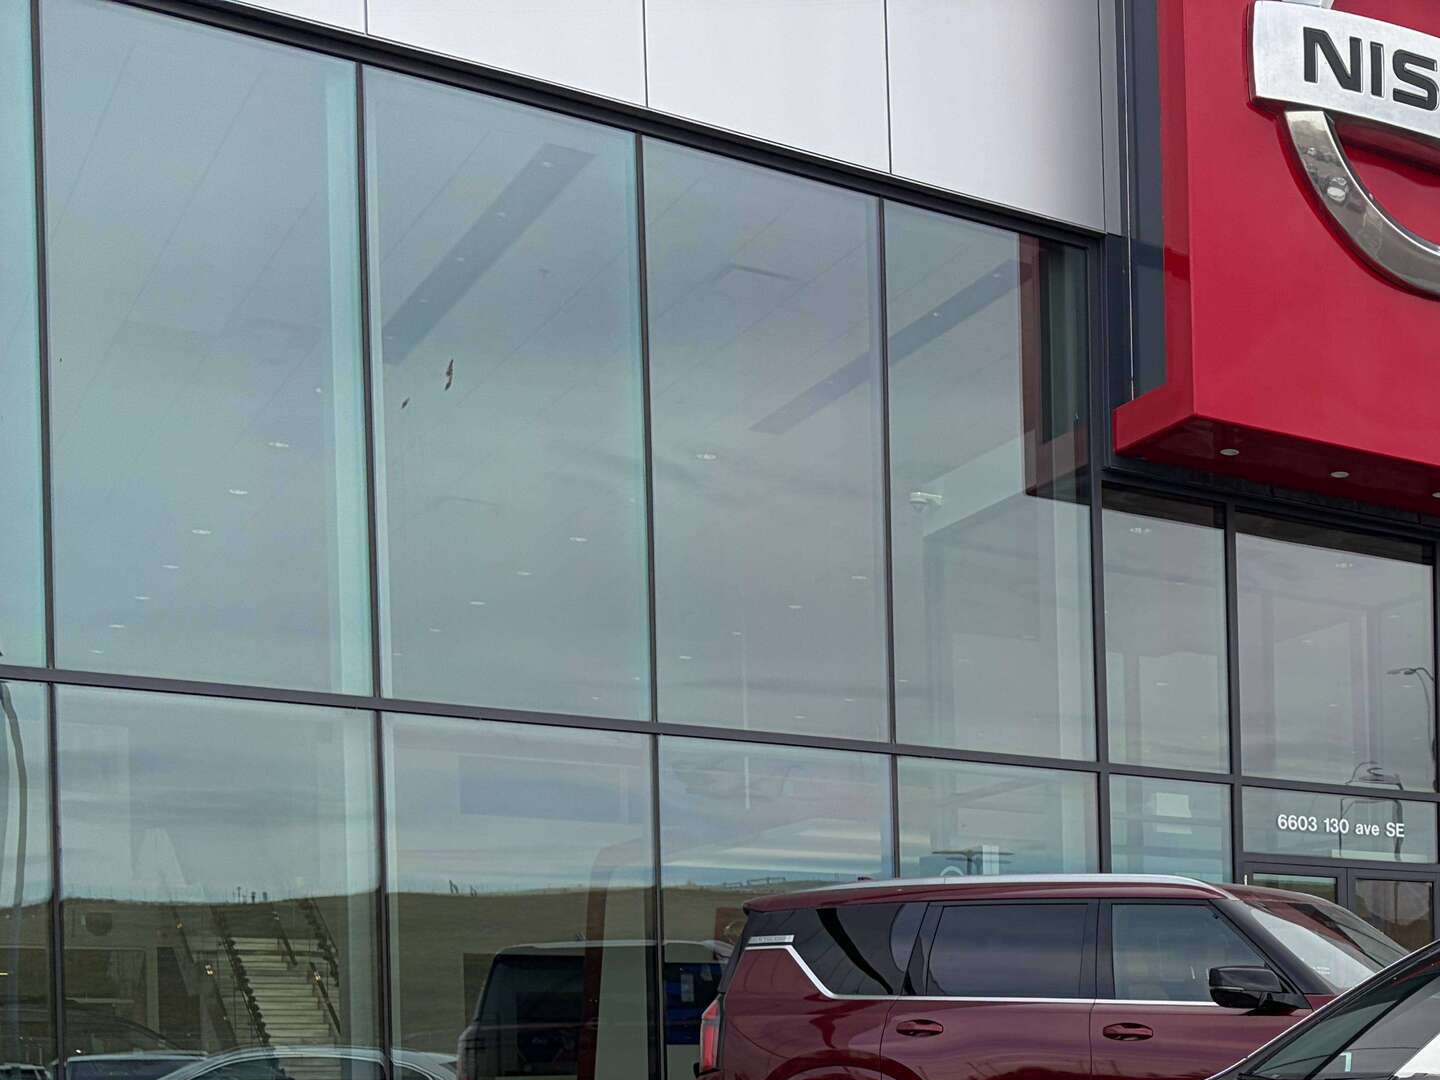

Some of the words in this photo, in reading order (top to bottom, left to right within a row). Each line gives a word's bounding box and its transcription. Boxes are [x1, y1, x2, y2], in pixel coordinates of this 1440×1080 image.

[1277, 814, 1318, 833] 6603
[1323, 817, 1350, 834] 130
[1355, 822, 1380, 836] ave
[1385, 822, 1405, 838] SE
